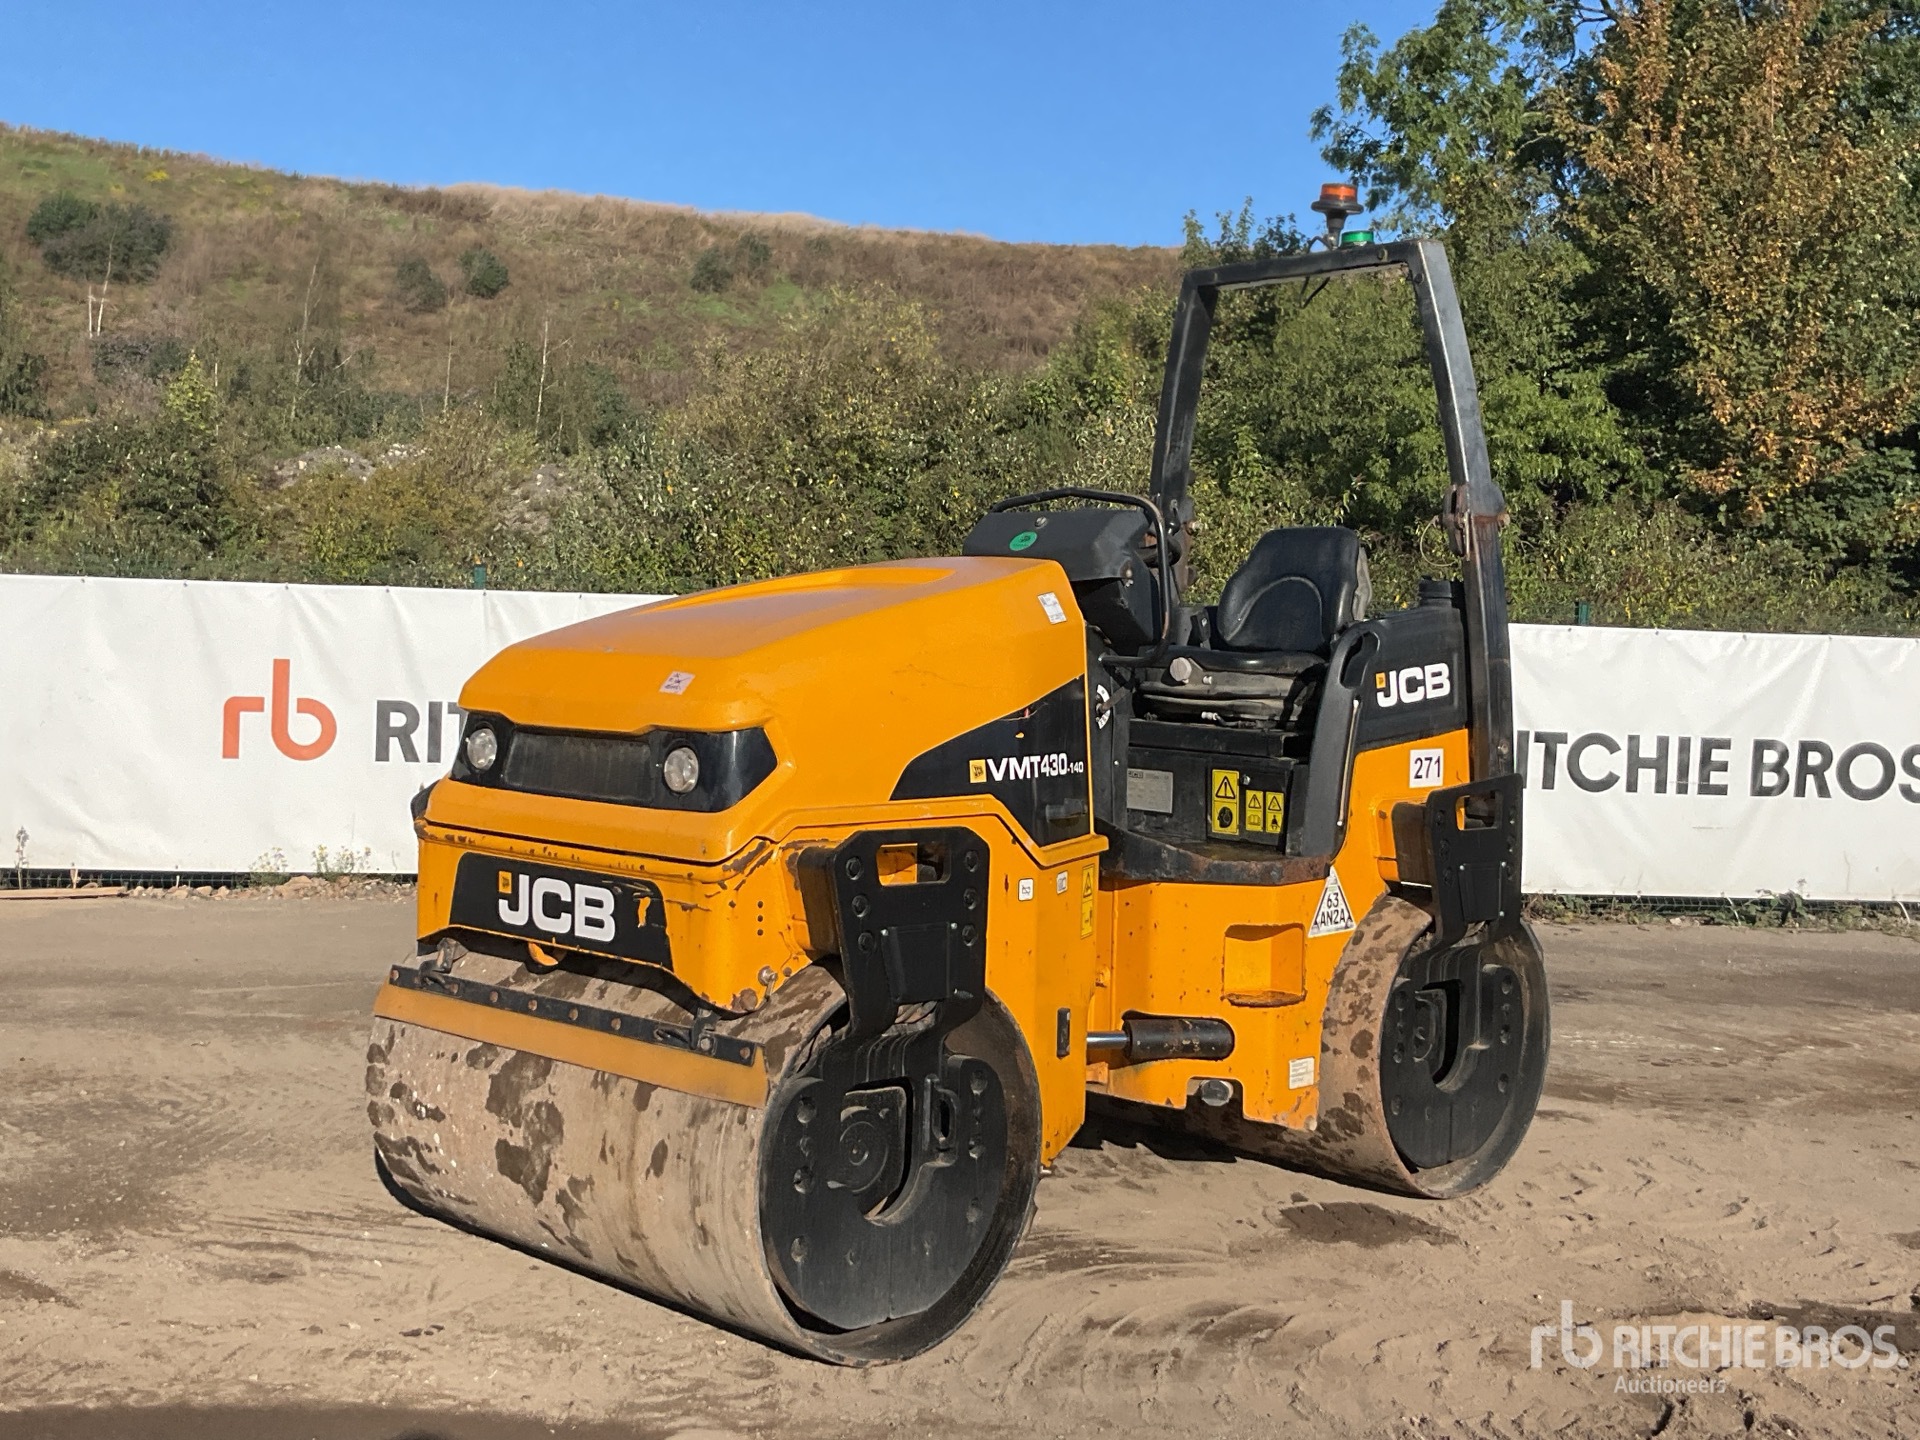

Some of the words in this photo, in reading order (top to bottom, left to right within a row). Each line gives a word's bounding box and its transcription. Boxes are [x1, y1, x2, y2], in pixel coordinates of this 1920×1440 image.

[222, 658, 338, 761] rb
[1377, 663, 1451, 708] JCB
[1413, 755, 1441, 780] 271
[1515, 730, 1731, 795] ITCHIE
[498, 872, 616, 943] JCB
[1327, 892, 1339, 909] 63
